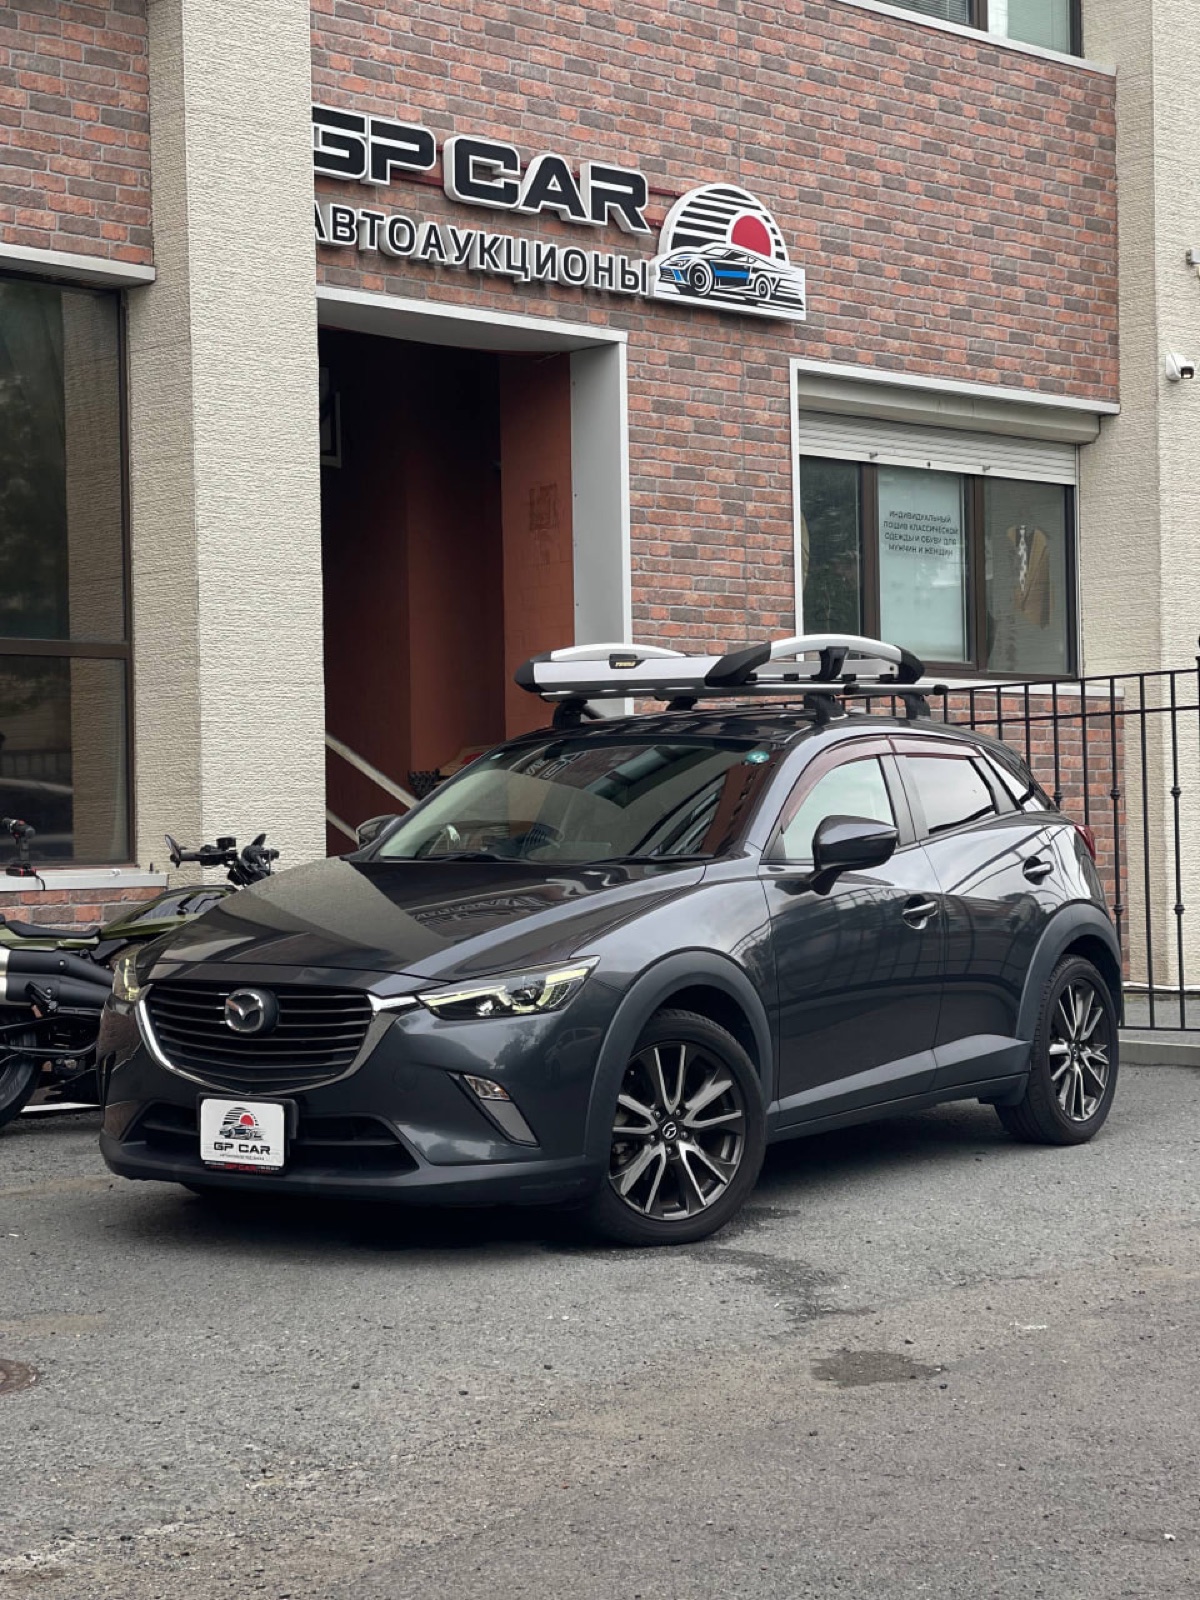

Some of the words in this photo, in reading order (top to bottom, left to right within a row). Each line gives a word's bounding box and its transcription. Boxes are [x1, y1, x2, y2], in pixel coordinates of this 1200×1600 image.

[312, 104, 437, 186] GP
[444, 135, 652, 236] CAR
[883, 520, 908, 530] ПОШИВ
[884, 532, 915, 542] ОДЕЖДЫ
[920, 536, 942, 545] ОБУВИ
[213, 1141, 235, 1152] GP
[238, 1143, 271, 1155] CAR
